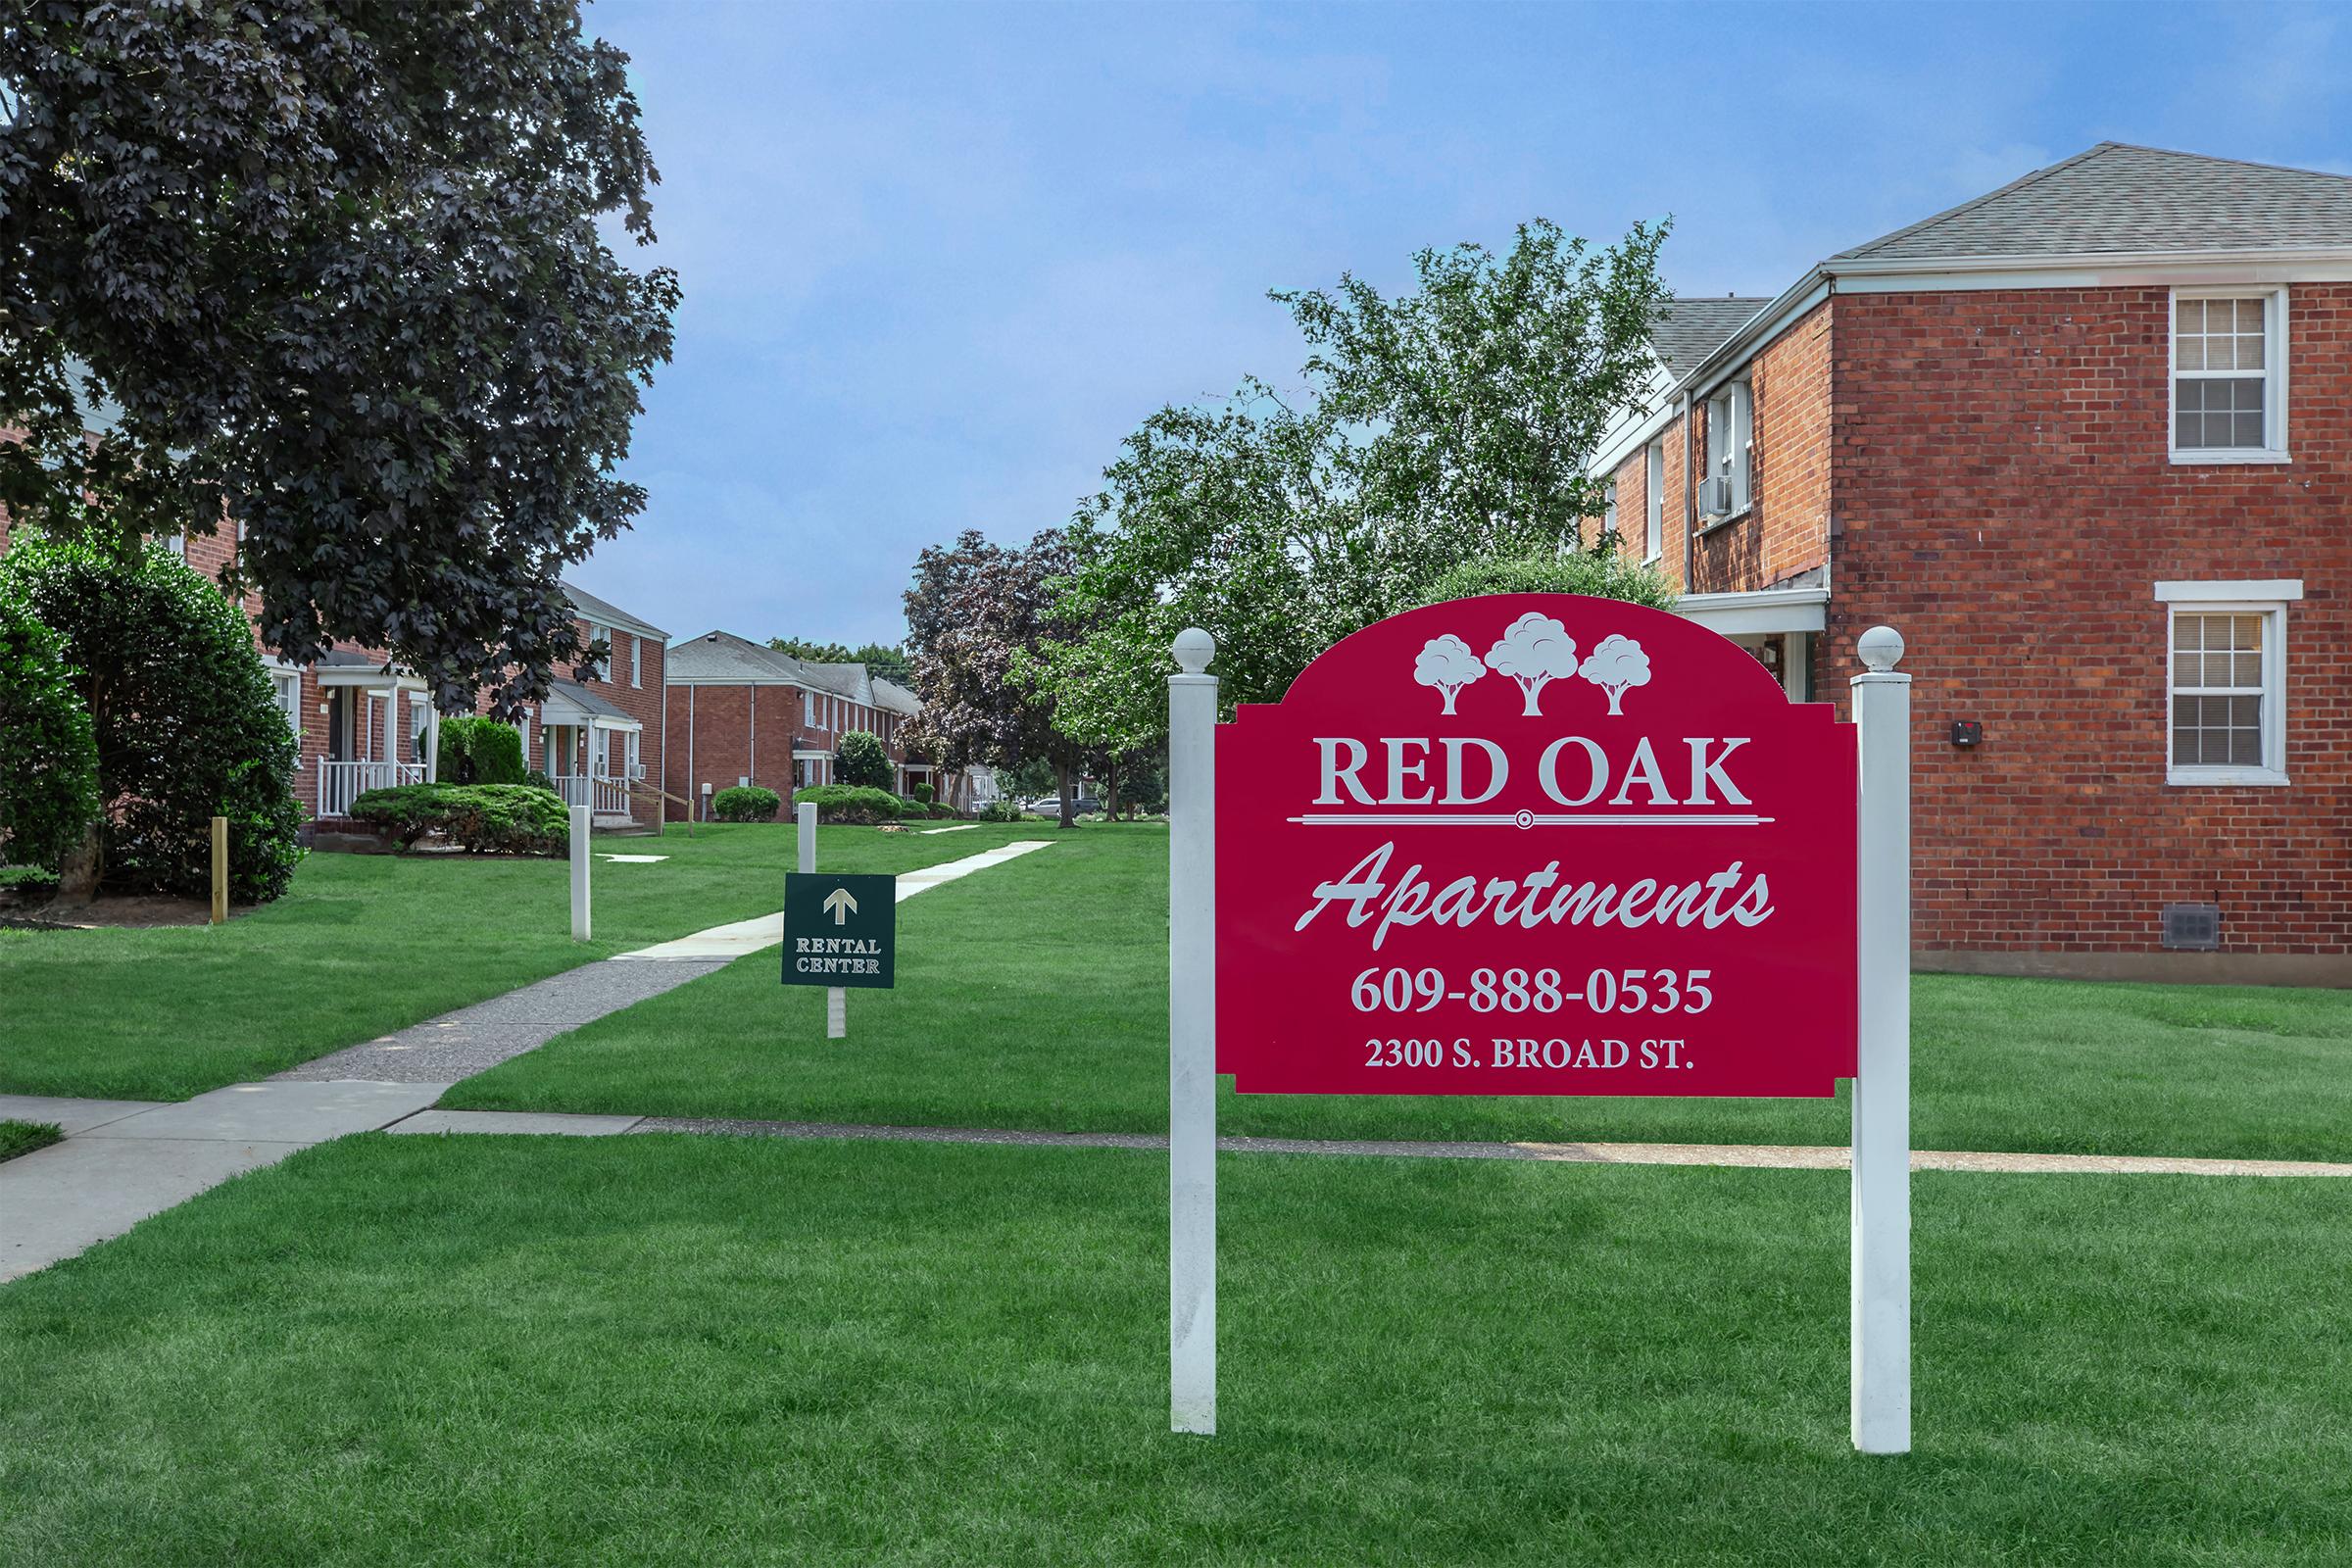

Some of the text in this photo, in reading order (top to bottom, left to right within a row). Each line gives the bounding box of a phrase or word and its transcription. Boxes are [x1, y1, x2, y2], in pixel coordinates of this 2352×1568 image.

[1312, 736, 1752, 807] RED OAK
[1295, 840, 1775, 952] Apartments
[796, 937, 882, 955] RENTAL
[796, 956, 880, 974] CENTER
[1350, 966, 1713, 1014] 609-888-0535
[1364, 1038, 1694, 1069] 2300 S. BROAD ST.
